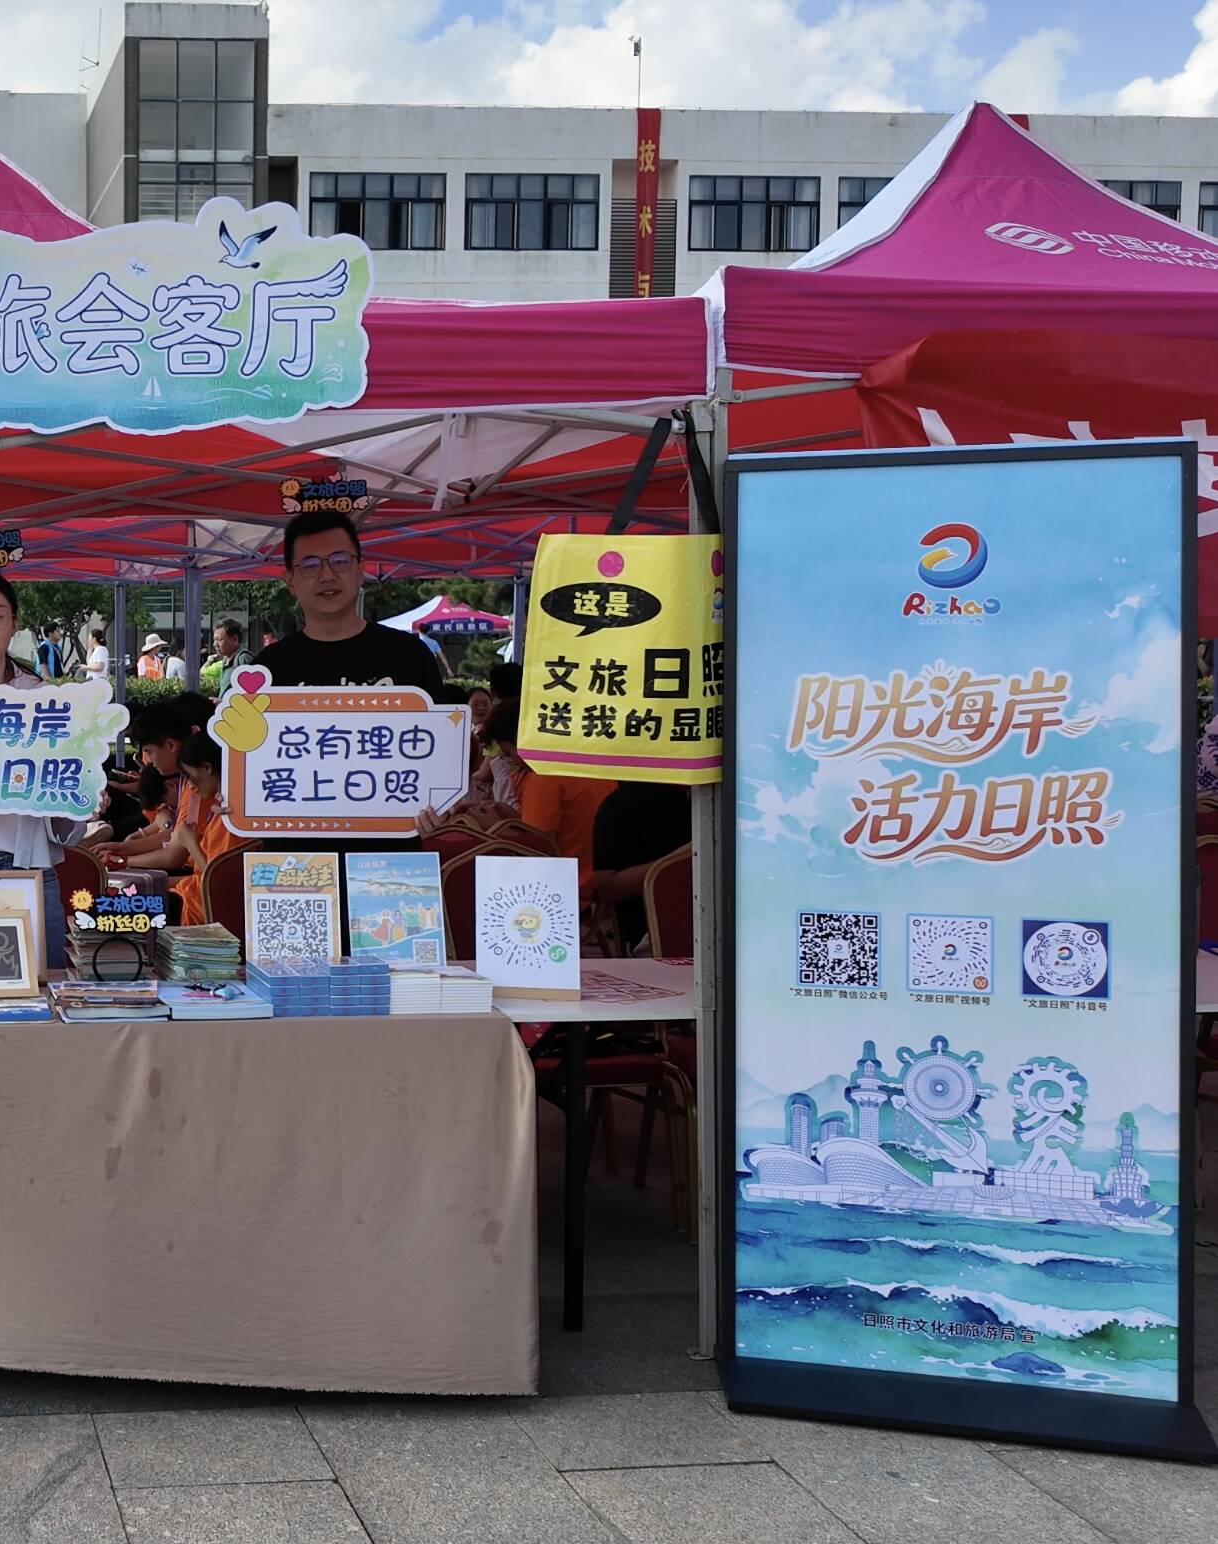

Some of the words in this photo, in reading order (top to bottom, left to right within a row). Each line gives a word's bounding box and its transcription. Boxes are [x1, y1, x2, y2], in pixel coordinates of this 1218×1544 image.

[638, 139, 656, 298] 技术与
[302, 480, 367, 496] 文旅日照
[573, 591, 630, 618] 这是
[902, 591, 1002, 617] Rizhao
[786, 666, 1074, 762] 阳光海岸
[277, 724, 435, 760] 总有理由
[262, 768, 420, 803] 爱上日照
[842, 772, 1112, 864] 活力日照
[96, 895, 164, 913] 文旅日照
[97, 914, 150, 932] 粉丝团
[863, 1313, 1015, 1342] 日照市文化和旅游局
[1021, 1328, 1036, 1343] 宣
